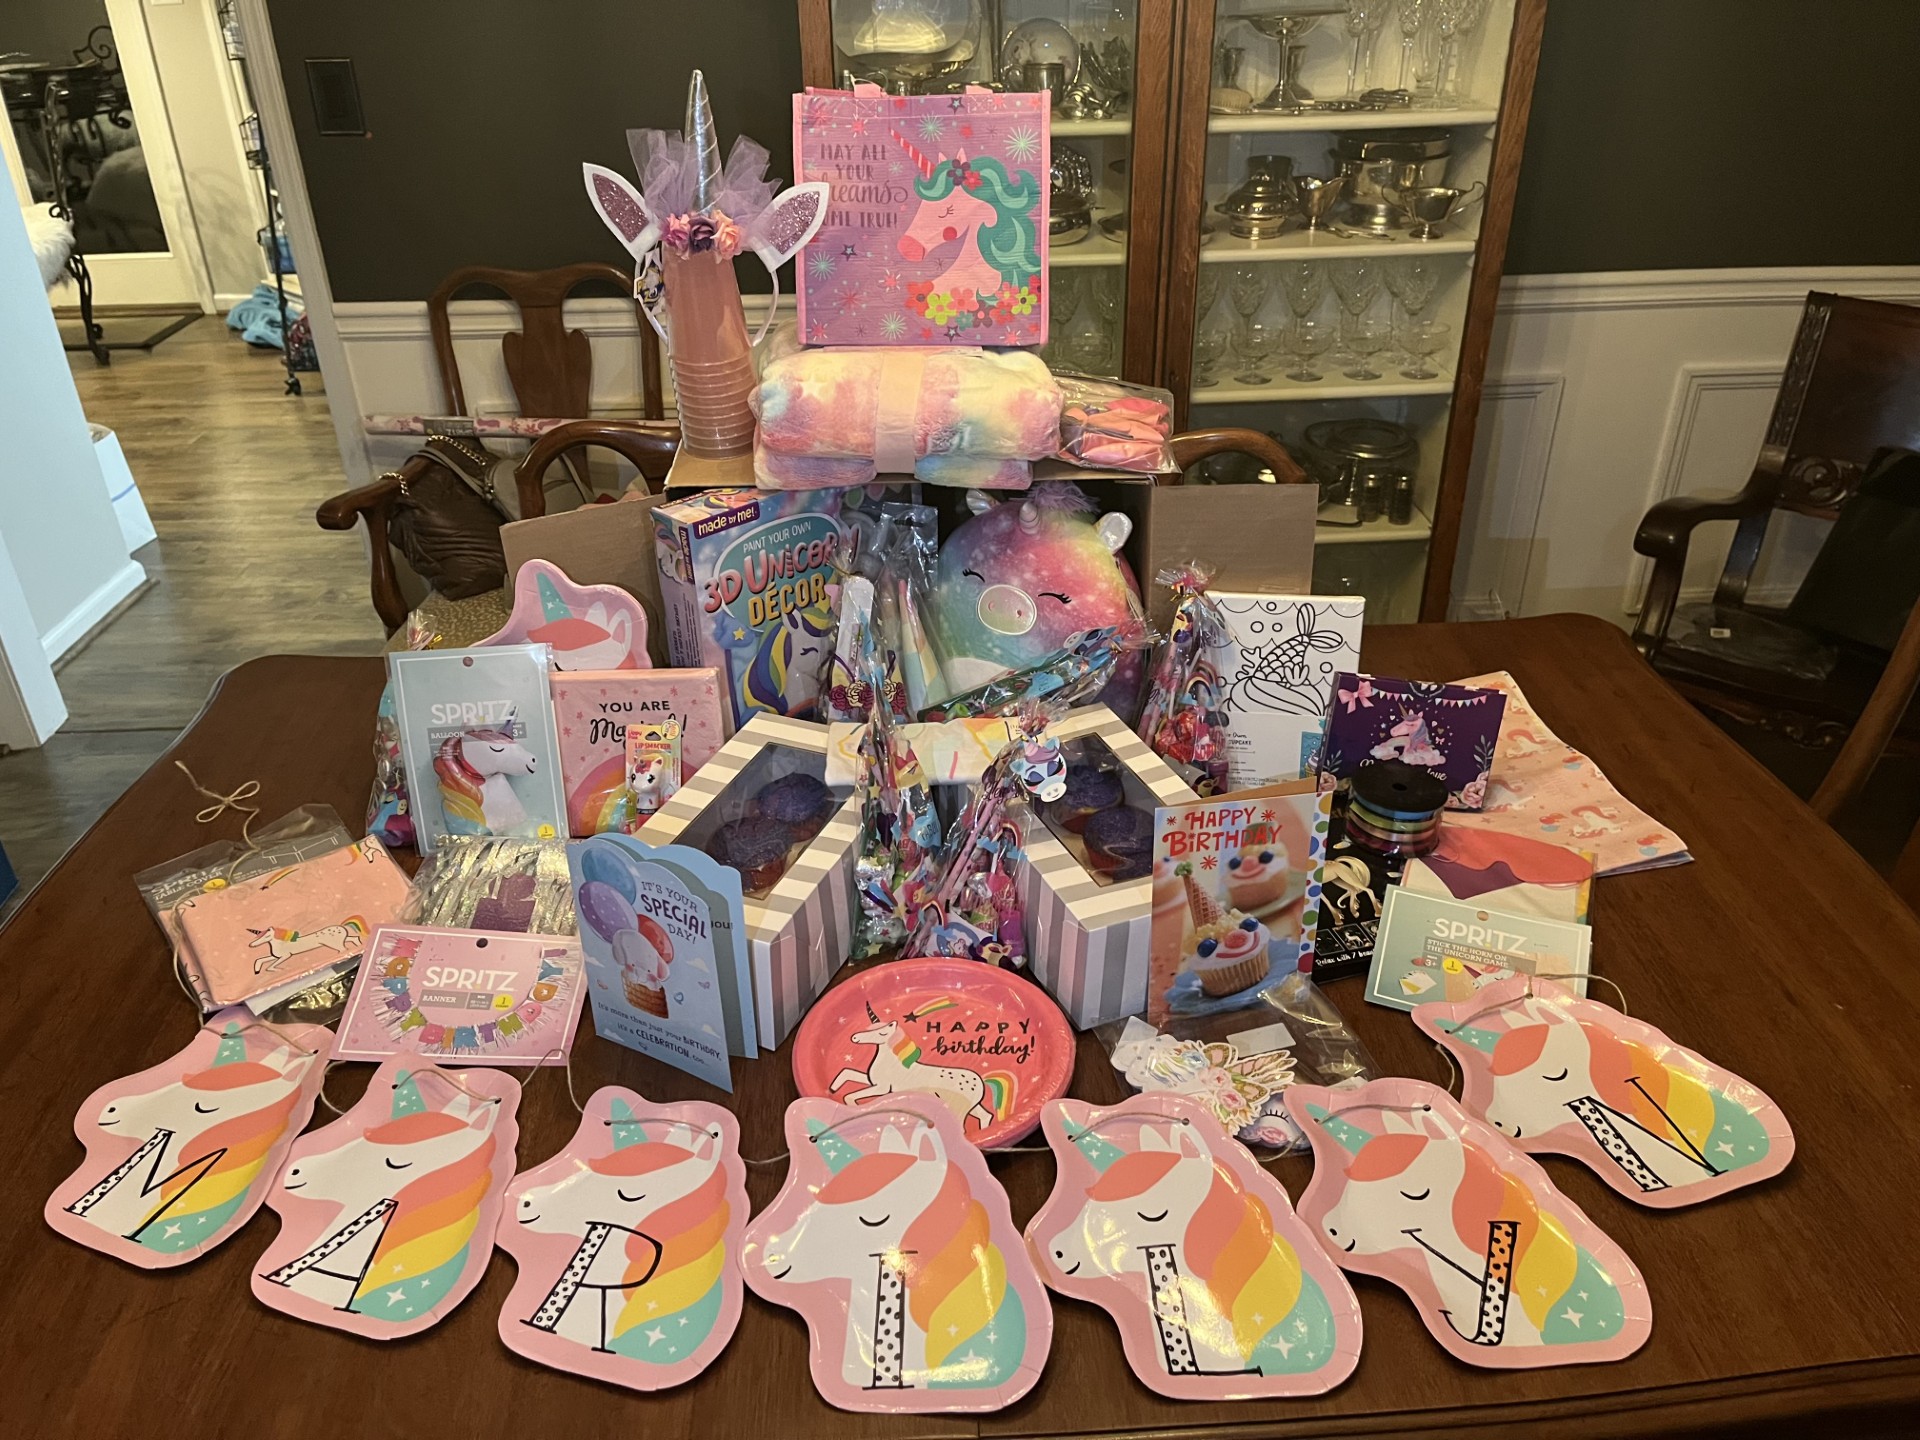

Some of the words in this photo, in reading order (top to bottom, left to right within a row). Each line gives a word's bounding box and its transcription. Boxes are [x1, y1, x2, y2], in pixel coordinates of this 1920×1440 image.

[820, 144, 853, 161] MAY
[861, 144, 887, 161] ALL
[835, 164, 874, 180] YOUR
[822, 210, 851, 227] OME
[860, 211, 898, 229] TRUE!
[698, 516, 728, 537] made
[728, 515, 737, 526] by
[737, 507, 755, 523] me!
[743, 540, 767, 554] PAINT
[768, 529, 791, 545] YOUR
[792, 521, 812, 536] OWN
[704, 568, 744, 614] 3D
[748, 572, 828, 627] DÉCOR
[599, 701, 633, 714] YOU
[640, 700, 671, 711] ARE
[431, 731, 465, 740] BALLOON
[1184, 806, 1257, 830] HAPPY
[186, 871, 223, 887] COVER
[641, 881, 663, 895] IT'S
[666, 887, 698, 914] YOUR
[667, 923, 696, 944] DAY!
[1427, 939, 1451, 949] STICK
[1451, 944, 1469, 953] THE
[1469, 947, 1493, 959] HORN
[1427, 945, 1443, 953] THE
[1444, 948, 1482, 963] UNICORN
[1483, 957, 1509, 968] GAME
[1425, 959, 1437, 967] 3+
[422, 993, 457, 1004] BANNER
[501, 996, 506, 1005] 1
[611, 1008, 629, 1020] more
[630, 1015, 648, 1027] than
[649, 1022, 663, 1033] just
[665, 1031, 681, 1042] your
[926, 1018, 1031, 1034] HAPPY
[931, 1035, 1036, 1064] birthday!
